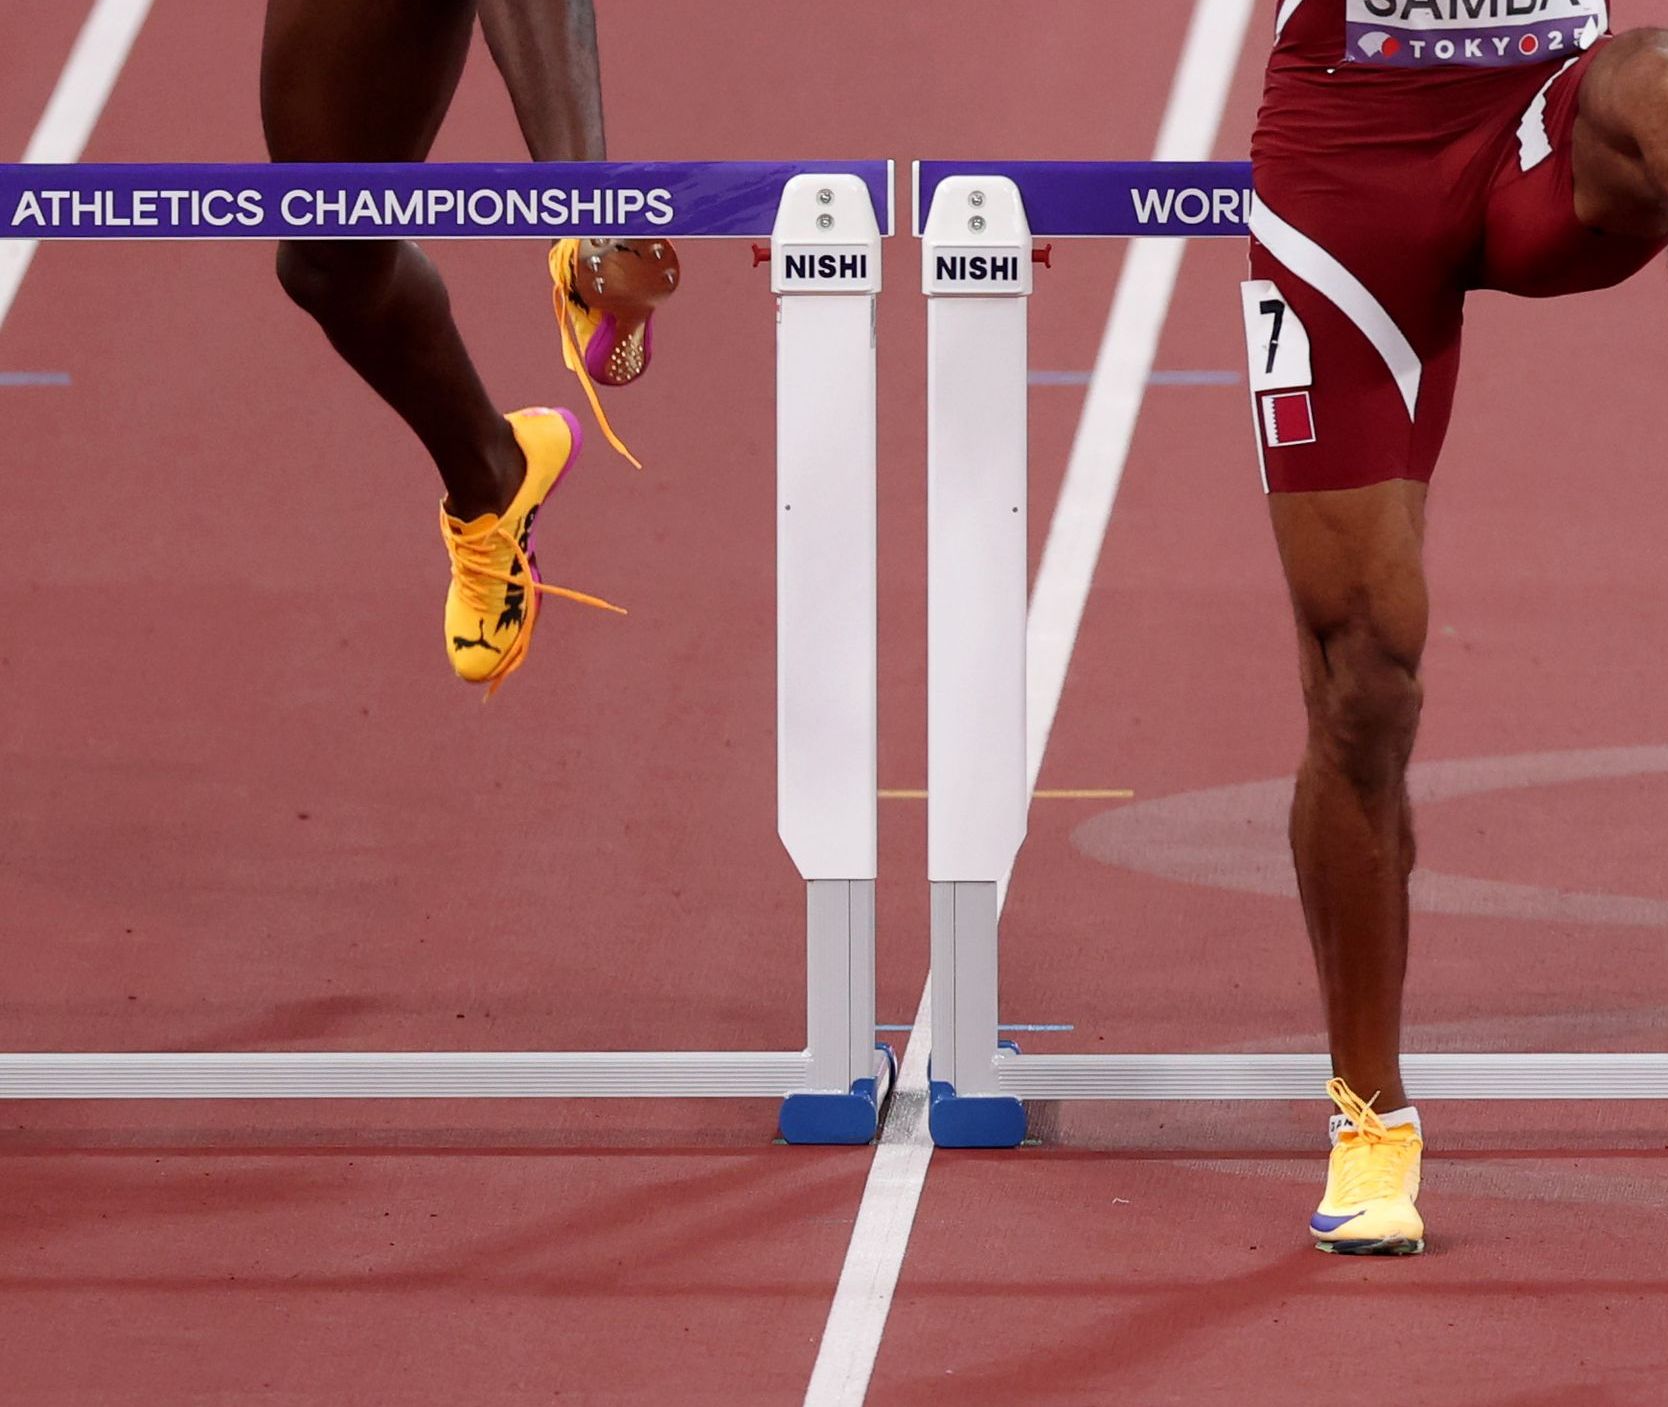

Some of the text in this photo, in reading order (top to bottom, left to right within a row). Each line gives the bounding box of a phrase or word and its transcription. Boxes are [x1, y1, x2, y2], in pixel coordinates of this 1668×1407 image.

[11, 188, 675, 226] ATHLETICS CHAMPIONSHIPS
[1130, 187, 1250, 225] WOR
[785, 254, 868, 279] NISHI
[935, 256, 1018, 281] NISHI
[1259, 299, 1285, 374] 7
